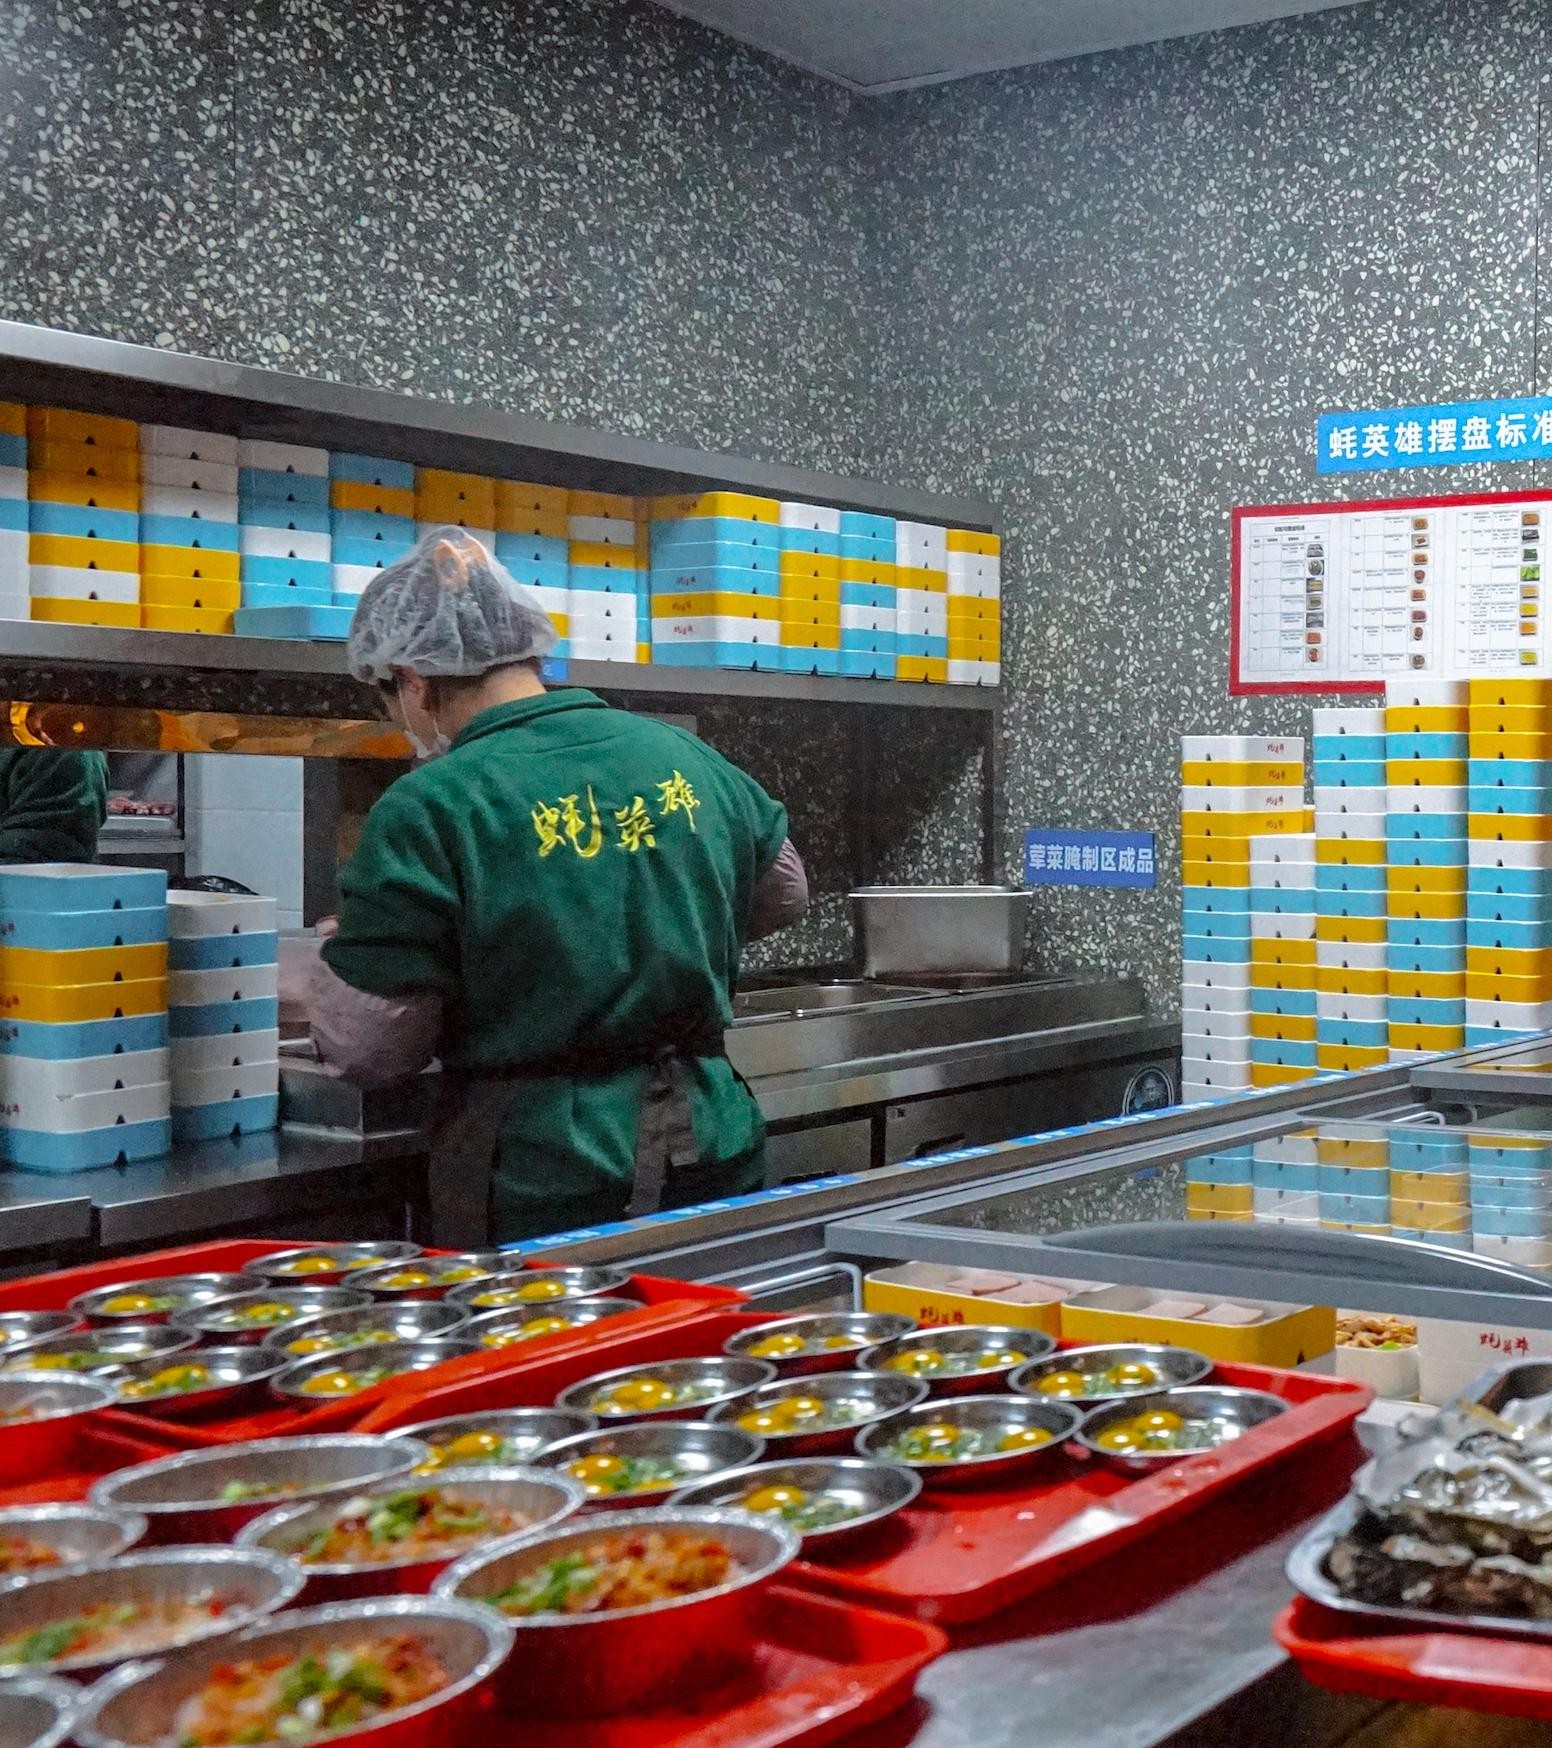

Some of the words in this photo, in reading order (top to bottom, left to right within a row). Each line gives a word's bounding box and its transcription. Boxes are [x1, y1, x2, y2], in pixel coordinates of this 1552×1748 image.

[1028, 843, 1154, 874] 荤菜腌制区成品
